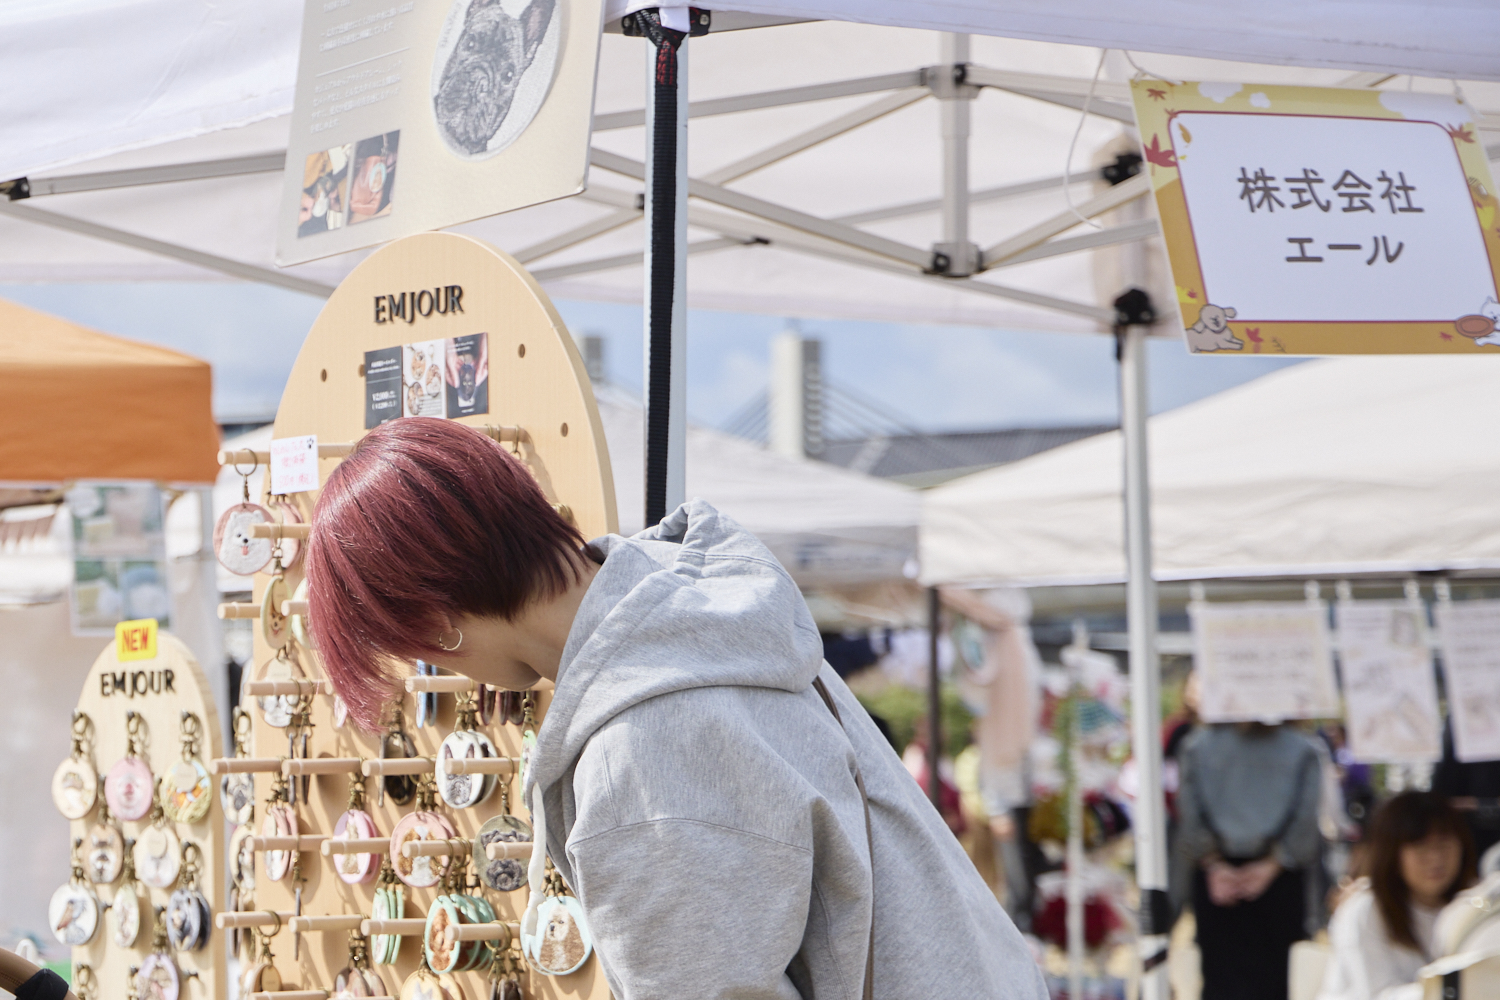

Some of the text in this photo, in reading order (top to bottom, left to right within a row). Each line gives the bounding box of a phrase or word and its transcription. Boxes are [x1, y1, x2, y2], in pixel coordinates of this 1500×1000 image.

[1237, 167, 1424, 214] 株式会社
[1285, 235, 1404, 266] エール
[374, 285, 464, 324] EMJOUR
[122, 627, 149, 653] NEW
[100, 669, 176, 699] EMJOUR
